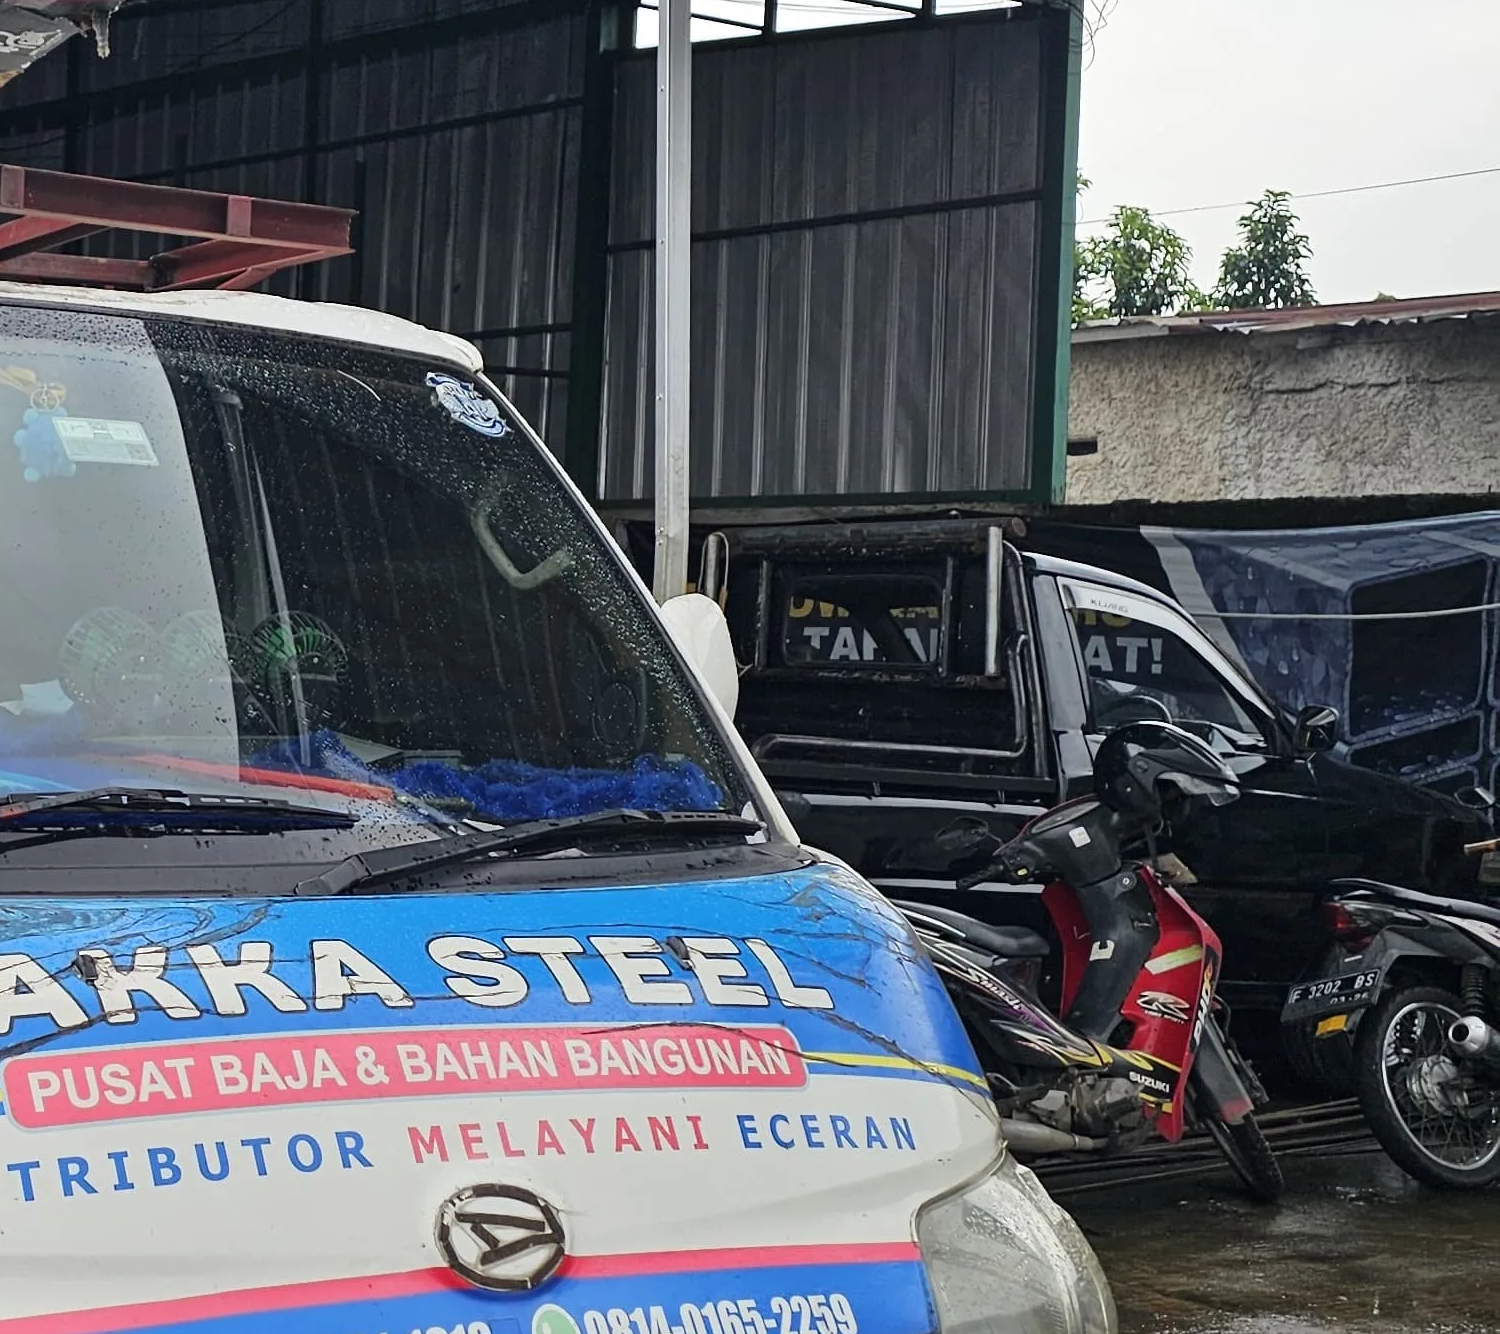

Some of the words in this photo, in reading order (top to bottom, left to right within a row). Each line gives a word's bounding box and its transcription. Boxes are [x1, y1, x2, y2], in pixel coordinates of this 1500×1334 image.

[425, 935, 835, 1010] STEEL
[1308, 980, 1342, 1000] 3202
[1354, 973, 1375, 989] BS
[27, 1060, 194, 1113] PUSAT
[214, 1046, 347, 1097] BAJA
[354, 1044, 391, 1085] &
[399, 1037, 556, 1082] BAHAN
[567, 1031, 790, 1080] BANGUNAN
[1129, 1071, 1170, 1094] SUZUKI
[411, 1115, 711, 1164] MELAYANI
[739, 1114, 918, 1153] ECERAN
